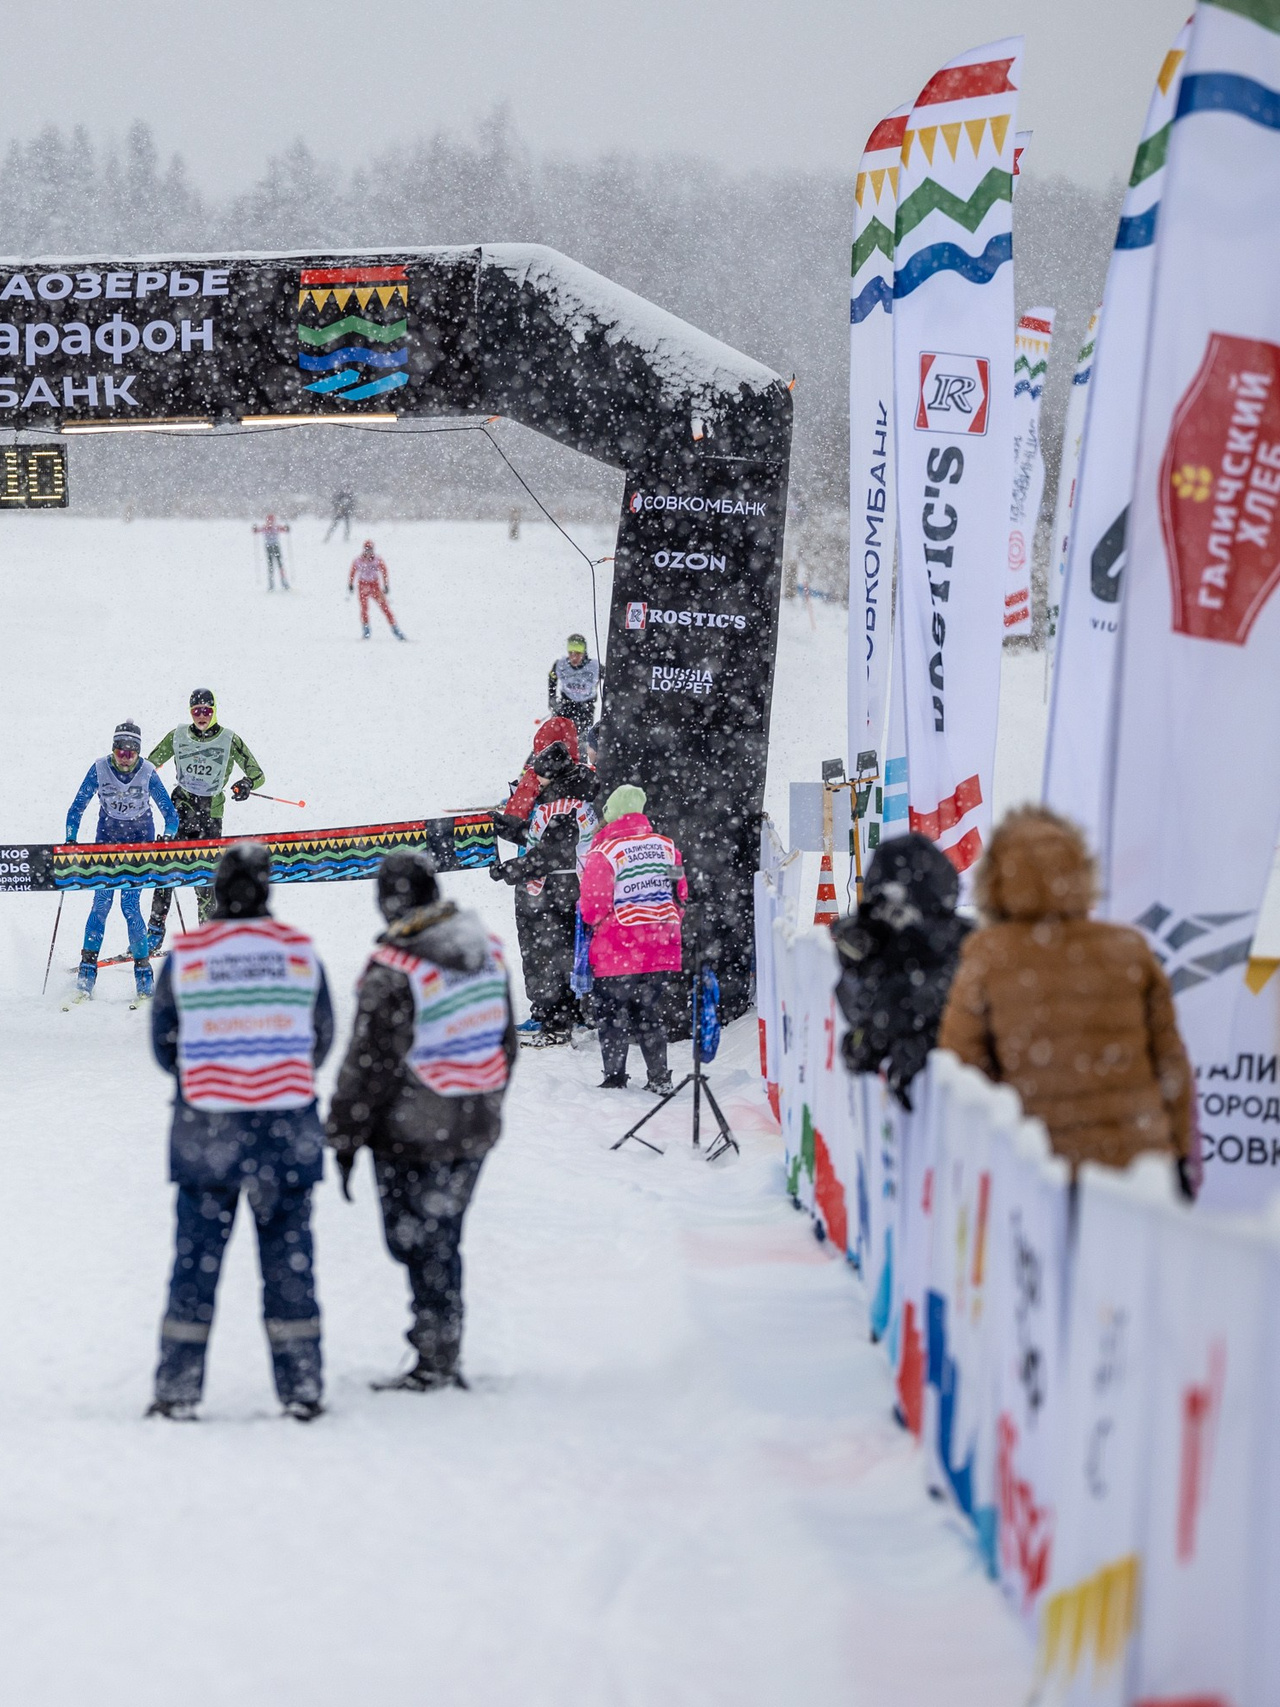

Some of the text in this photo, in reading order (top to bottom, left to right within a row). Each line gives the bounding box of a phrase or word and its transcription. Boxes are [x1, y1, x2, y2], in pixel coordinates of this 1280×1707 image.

[1197, 371, 1272, 611] ГАЛИЧСКИЙ
[644, 495, 767, 516] СОВКОМБАНК
[654, 550, 726, 573] OZON
[648, 609, 747, 630] ROSTIC'S
[652, 666, 713, 683] RUSSIA
[186, 763, 213, 776] 6122
[624, 843, 663, 854] ГАЛИЧСКОЕ
[628, 851, 666, 863] ЗАОЗЕРЬЕ
